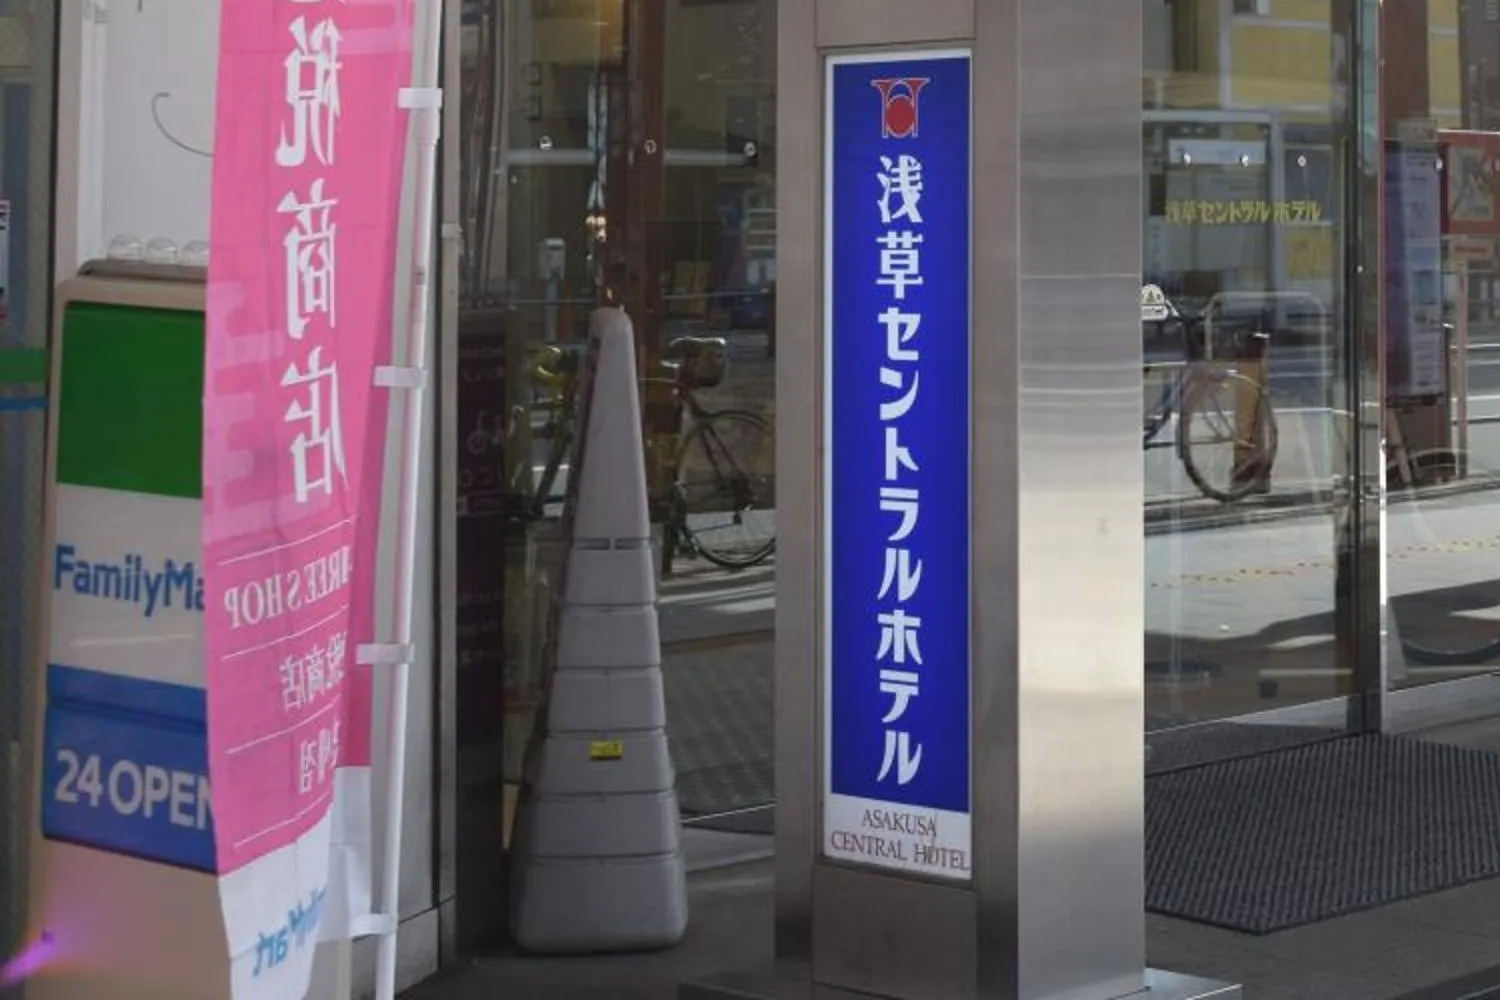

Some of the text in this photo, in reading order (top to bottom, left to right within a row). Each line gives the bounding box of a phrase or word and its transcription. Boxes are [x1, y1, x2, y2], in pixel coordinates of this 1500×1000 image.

[876, 154, 925, 787] 浅草セントラルホテル
[55, 749, 104, 808] 24
[861, 808, 938, 838] ASAKUSA
[830, 829, 971, 872] CENTRAL HOTEL
